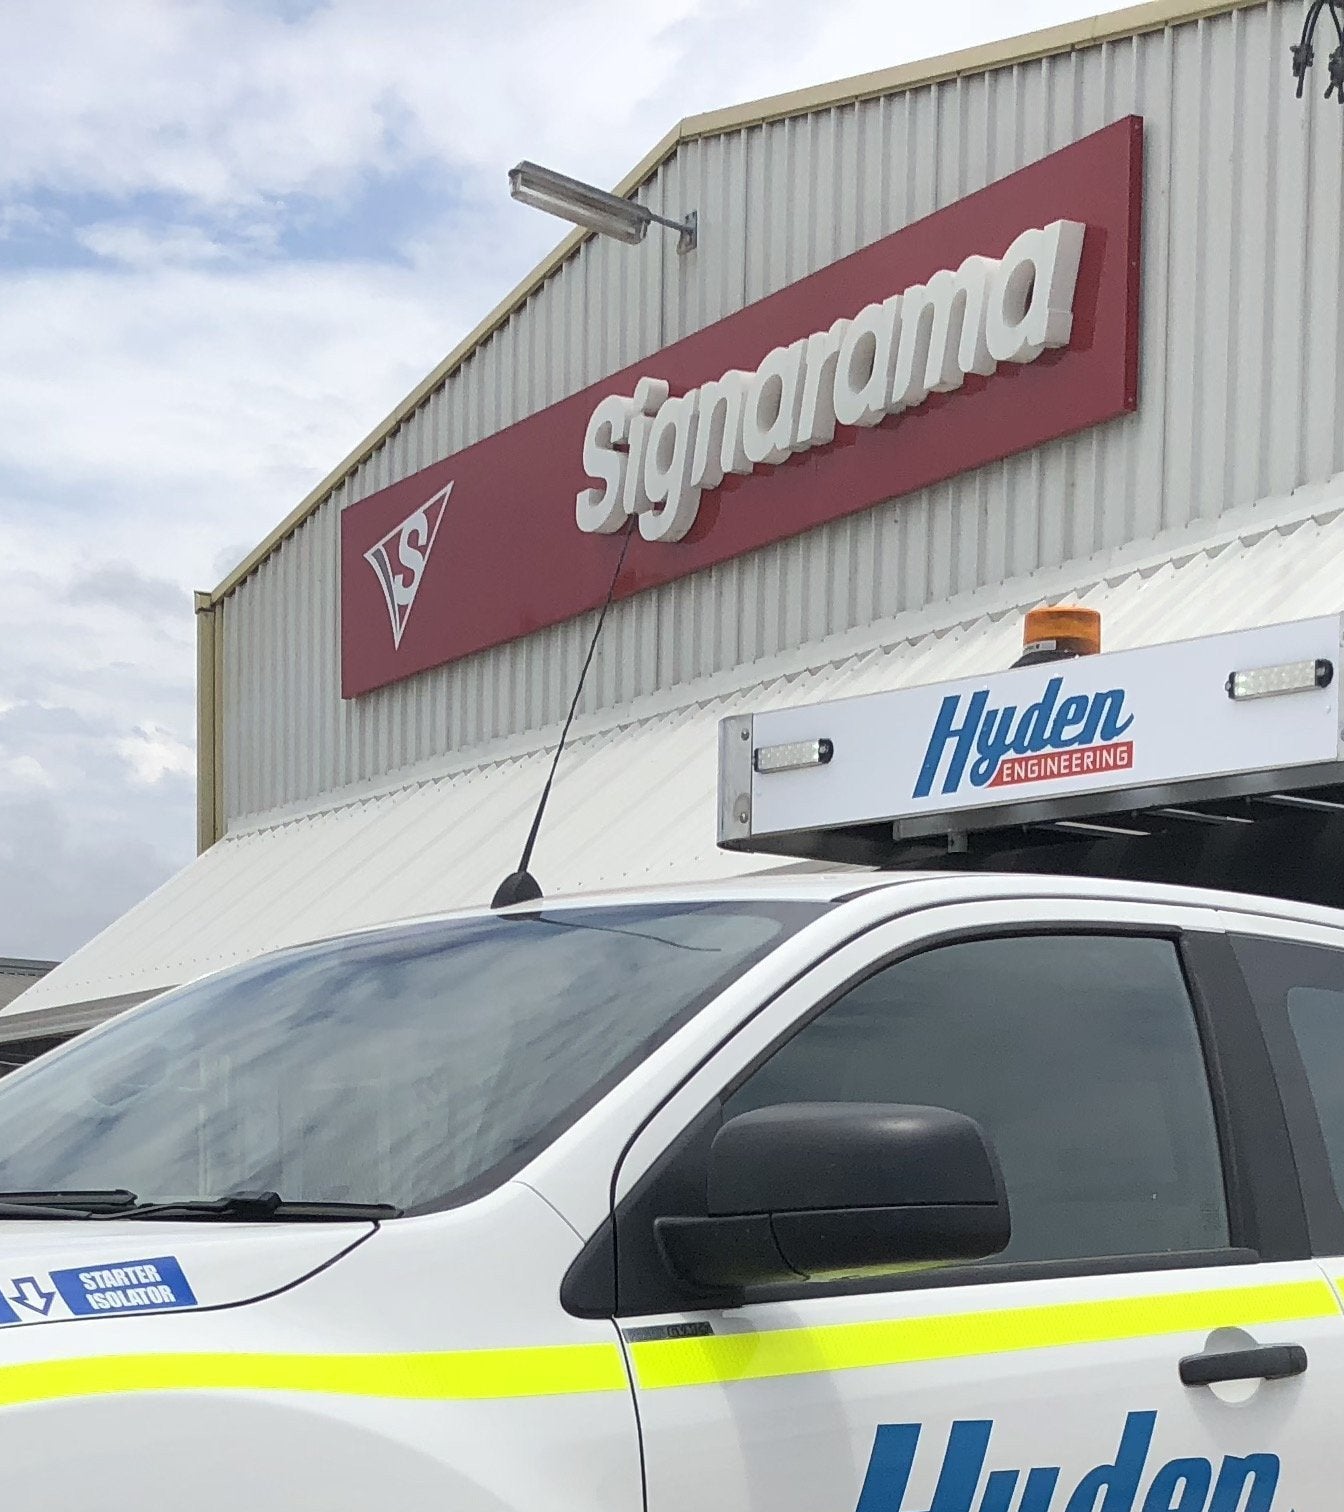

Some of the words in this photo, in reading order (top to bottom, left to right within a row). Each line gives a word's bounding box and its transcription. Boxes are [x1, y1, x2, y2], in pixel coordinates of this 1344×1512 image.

[575, 220, 1086, 543] Signarama
[912, 677, 1135, 799] Hyden
[1002, 746, 1129, 782] ENGINEERING
[79, 1264, 162, 1291] STARTER
[85, 1285, 176, 1311] ISOLATOR
